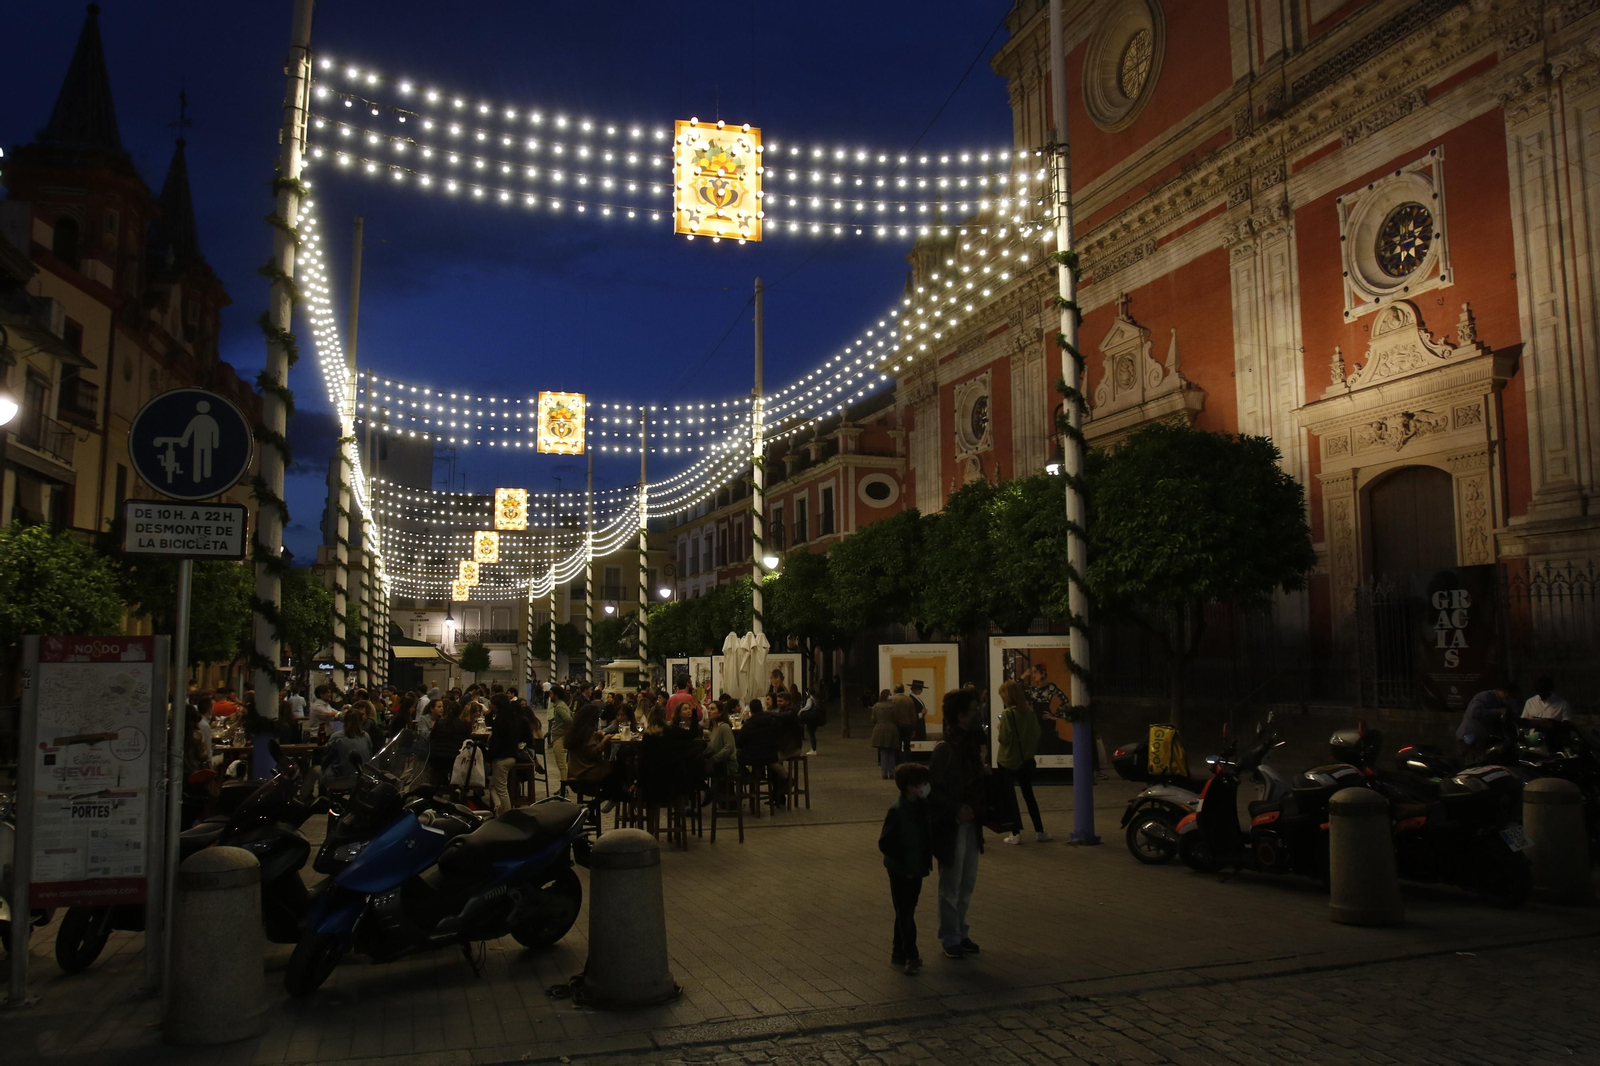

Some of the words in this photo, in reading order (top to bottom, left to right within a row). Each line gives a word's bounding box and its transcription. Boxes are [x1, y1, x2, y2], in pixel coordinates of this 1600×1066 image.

[134, 508, 153, 519] DE
[157, 509, 171, 520] 10
[174, 510, 186, 520] H.
[190, 511, 200, 521] A
[204, 511, 221, 522] 22
[223, 512, 235, 522] H.
[135, 523, 212, 536] DESMONTE
[216, 526, 233, 536] DE
[138, 538, 155, 548] LA
[160, 538, 228, 550] BICICLETA
[71, 805, 110, 818] PORTES
